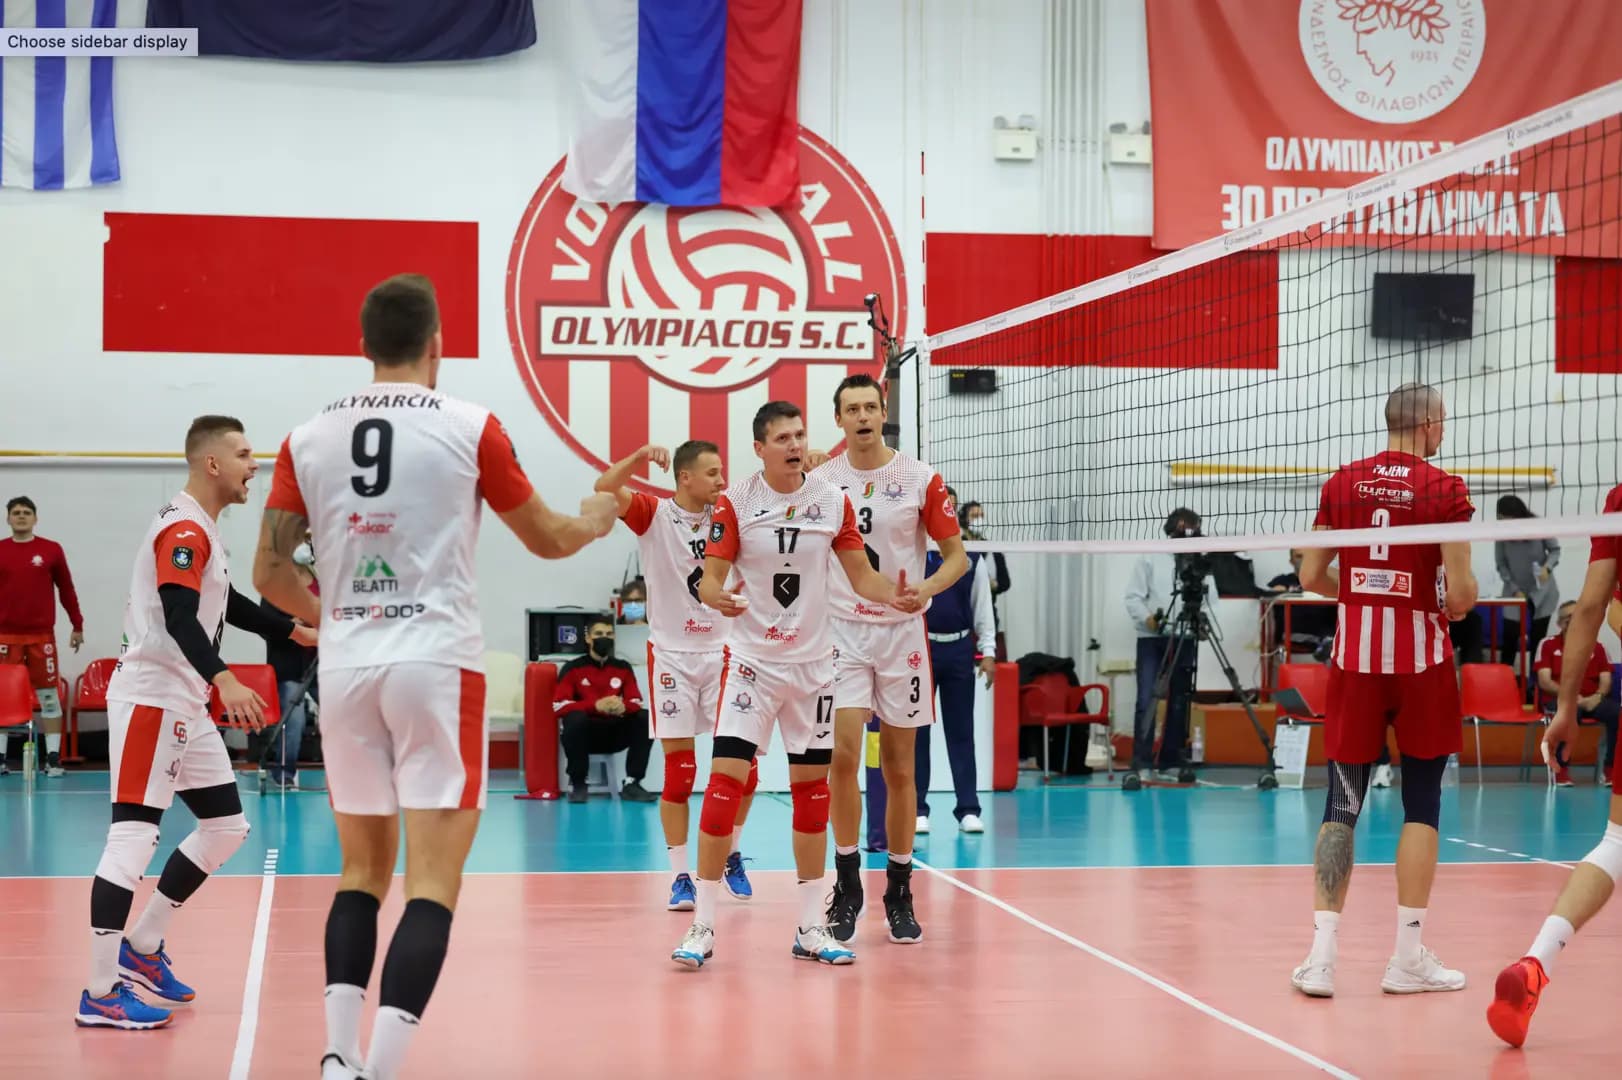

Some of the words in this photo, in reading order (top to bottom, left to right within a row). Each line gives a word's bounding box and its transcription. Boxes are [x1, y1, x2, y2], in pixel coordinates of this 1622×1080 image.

[551, 316, 793, 348] OLYMPIACOS
[800, 321, 866, 350] S.C.
[351, 418, 393, 497] 9
[859, 507, 872, 534] 3
[688, 539, 706, 560] 18
[774, 528, 800, 553] 17
[909, 676, 920, 703] 3
[816, 695, 834, 724] 17
